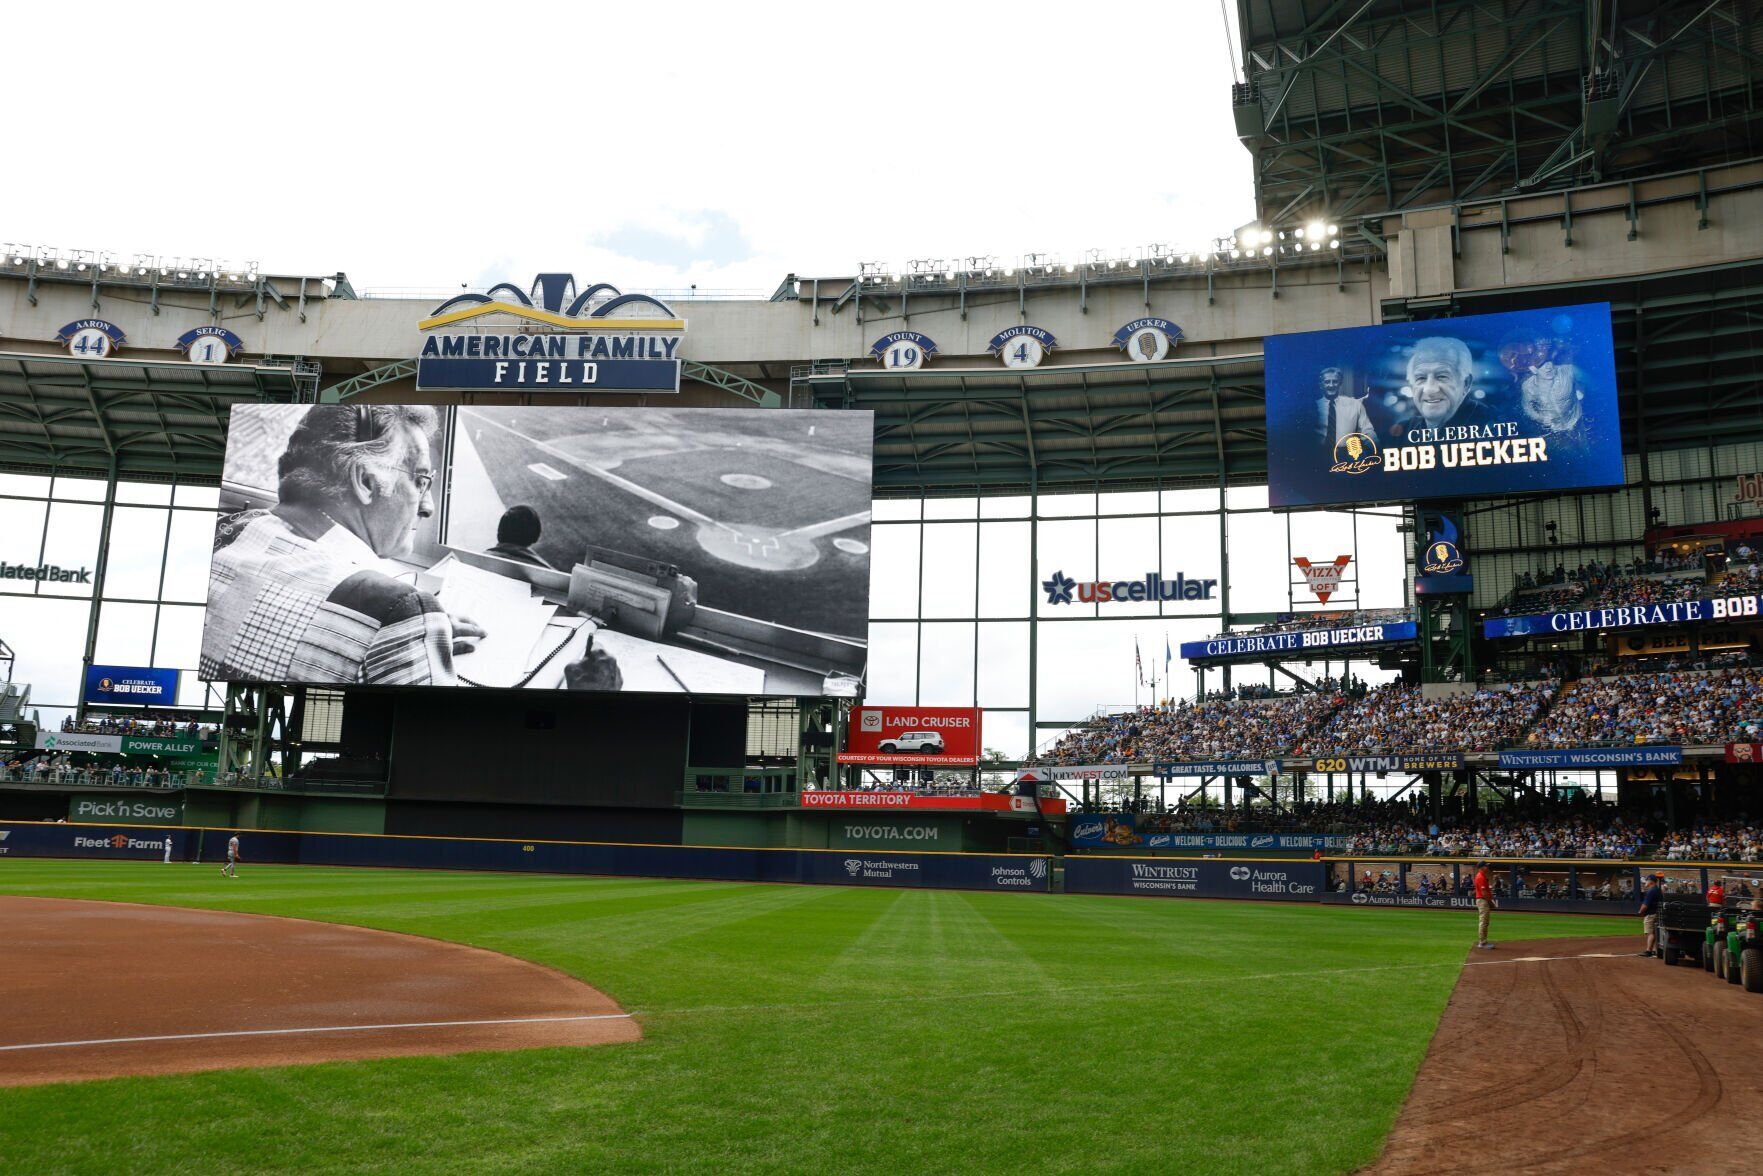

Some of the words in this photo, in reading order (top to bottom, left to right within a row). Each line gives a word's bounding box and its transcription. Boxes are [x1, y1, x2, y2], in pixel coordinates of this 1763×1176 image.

[76, 319, 111, 331] AARON
[1127, 319, 1168, 332] UECKER
[196, 327, 227, 337] SELIG
[887, 332, 922, 343] YOUNT
[999, 326, 1046, 341] MOLITOR
[74, 335, 104, 356] 44
[421, 335, 567, 358] AMERICAN
[578, 335, 680, 358] FAMILY
[203, 344, 214, 362] 1
[889, 348, 917, 369] 19
[1013, 343, 1028, 363] 4
[494, 362, 598, 383] FIELD
[1408, 422, 1519, 443] CELEBRATE
[1382, 445, 1436, 472] BOB
[1440, 437, 1548, 469] UECKER
[1302, 567, 1343, 577] VIZZY
[1077, 571, 1217, 603] uscellular
[1311, 583, 1336, 591] LOFT
[1552, 601, 1702, 632] CELEBRATE
[1712, 596, 1758, 618] BOB
[1207, 634, 1297, 656] CELEBRATE
[1302, 630, 1329, 647] BOB
[1331, 626, 1384, 645] UECKER
[113, 684, 130, 693] BOB
[131, 685, 162, 694] UECKER
[886, 716, 919, 727] LAND
[921, 717, 970, 728] CRUISER
[128, 741, 163, 751] POWER
[164, 743, 195, 753] ALLEY
[1316, 758, 1347, 772] 620
[1349, 756, 1400, 771] WTMJ
[1501, 755, 1560, 765] WINTRUST
[1571, 752, 1643, 763] WISCONSIN'S
[1646, 752, 1678, 761] BANK
[1171, 765, 1195, 774] GREAT
[1196, 764, 1216, 773] TASTE.
[1217, 764, 1227, 773] 96
[1228, 763, 1264, 772] CALORIES.
[1404, 761, 1458, 769] BREWERS
[804, 794, 847, 804] TOYOTA
[848, 794, 911, 805] TERRITORY
[79, 801, 115, 816] Pick
[132, 803, 176, 818] Save
[845, 825, 938, 840] TOYOTA.COM
[74, 836, 111, 848] Fleet
[128, 838, 163, 850] Farm
[1174, 835, 1205, 846] WELCOME
[1215, 835, 1248, 847] DELICIOUS
[1280, 836, 1313, 848] WELCOME
[863, 860, 919, 870] Northwestern
[1132, 863, 1198, 879] WINTRUST
[863, 869, 892, 878] Mutual
[991, 866, 1025, 877] Johnson
[1252, 869, 1287, 881] Aurora
[997, 876, 1032, 886] Controls
[1133, 881, 1177, 890] WISCONSIN'S
[1177, 882, 1196, 891] BANK
[1252, 881, 1286, 893] Health
[1288, 882, 1314, 894] Care
[1368, 895, 1395, 904] Aurora
[1396, 896, 1423, 906] Health
[1425, 897, 1445, 906] Care
[1451, 897, 1499, 909] BULLN
